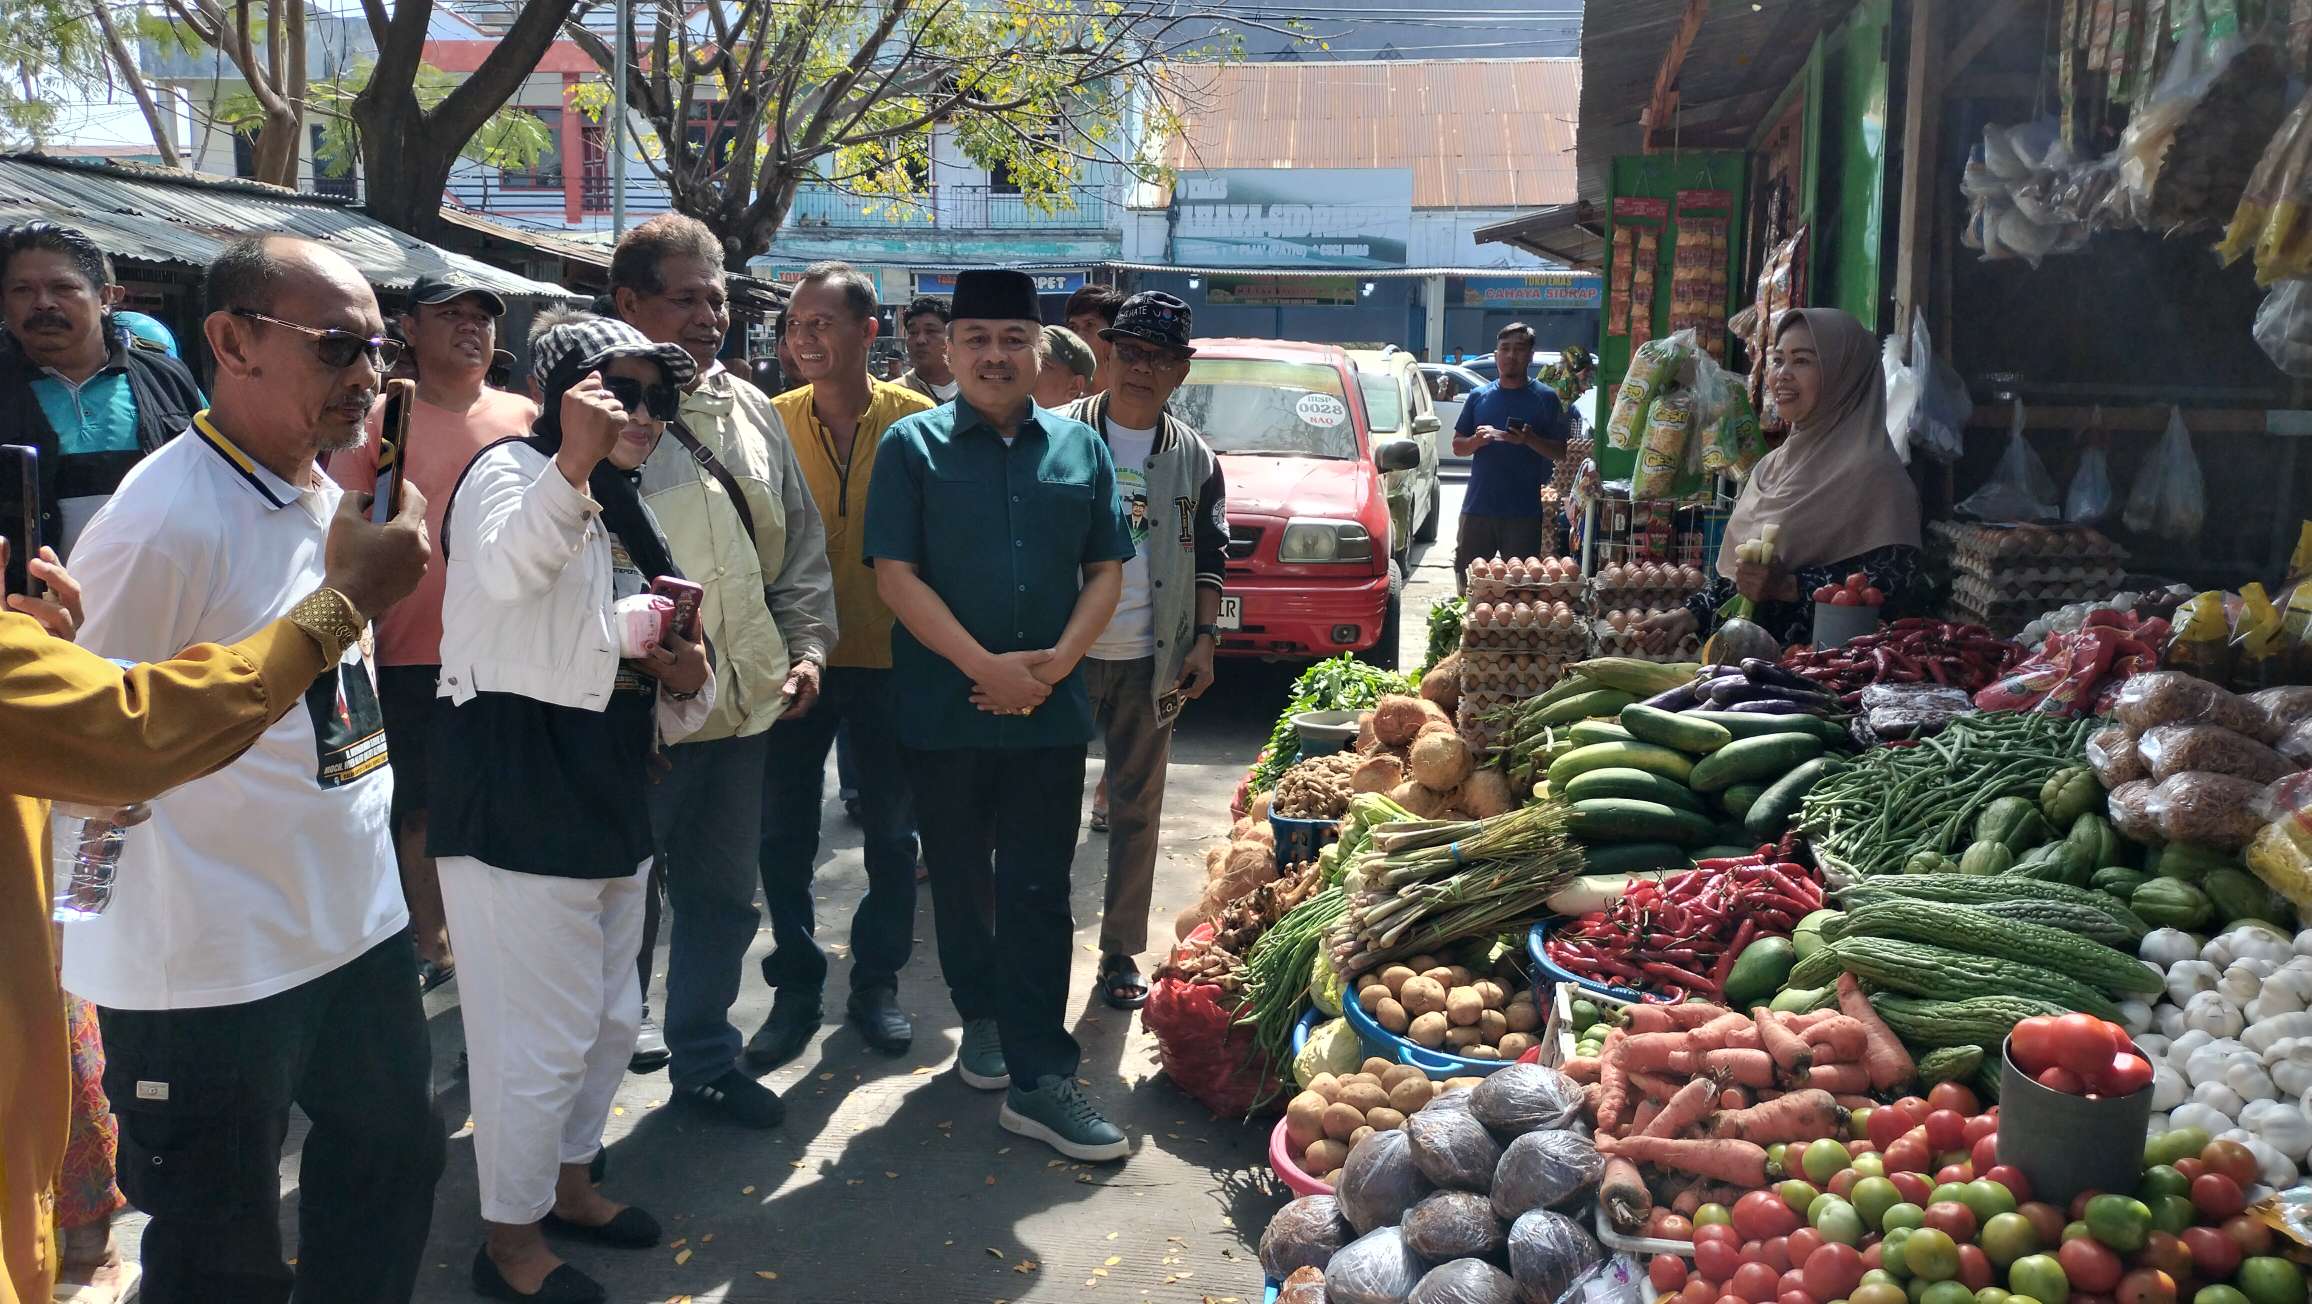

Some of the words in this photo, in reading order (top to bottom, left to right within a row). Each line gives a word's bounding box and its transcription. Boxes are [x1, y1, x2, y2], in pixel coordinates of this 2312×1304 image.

[1486, 287, 1541, 299] CAHAYA
[1545, 287, 1597, 299] SIDRAP
[1299, 403, 1343, 415] 0028
